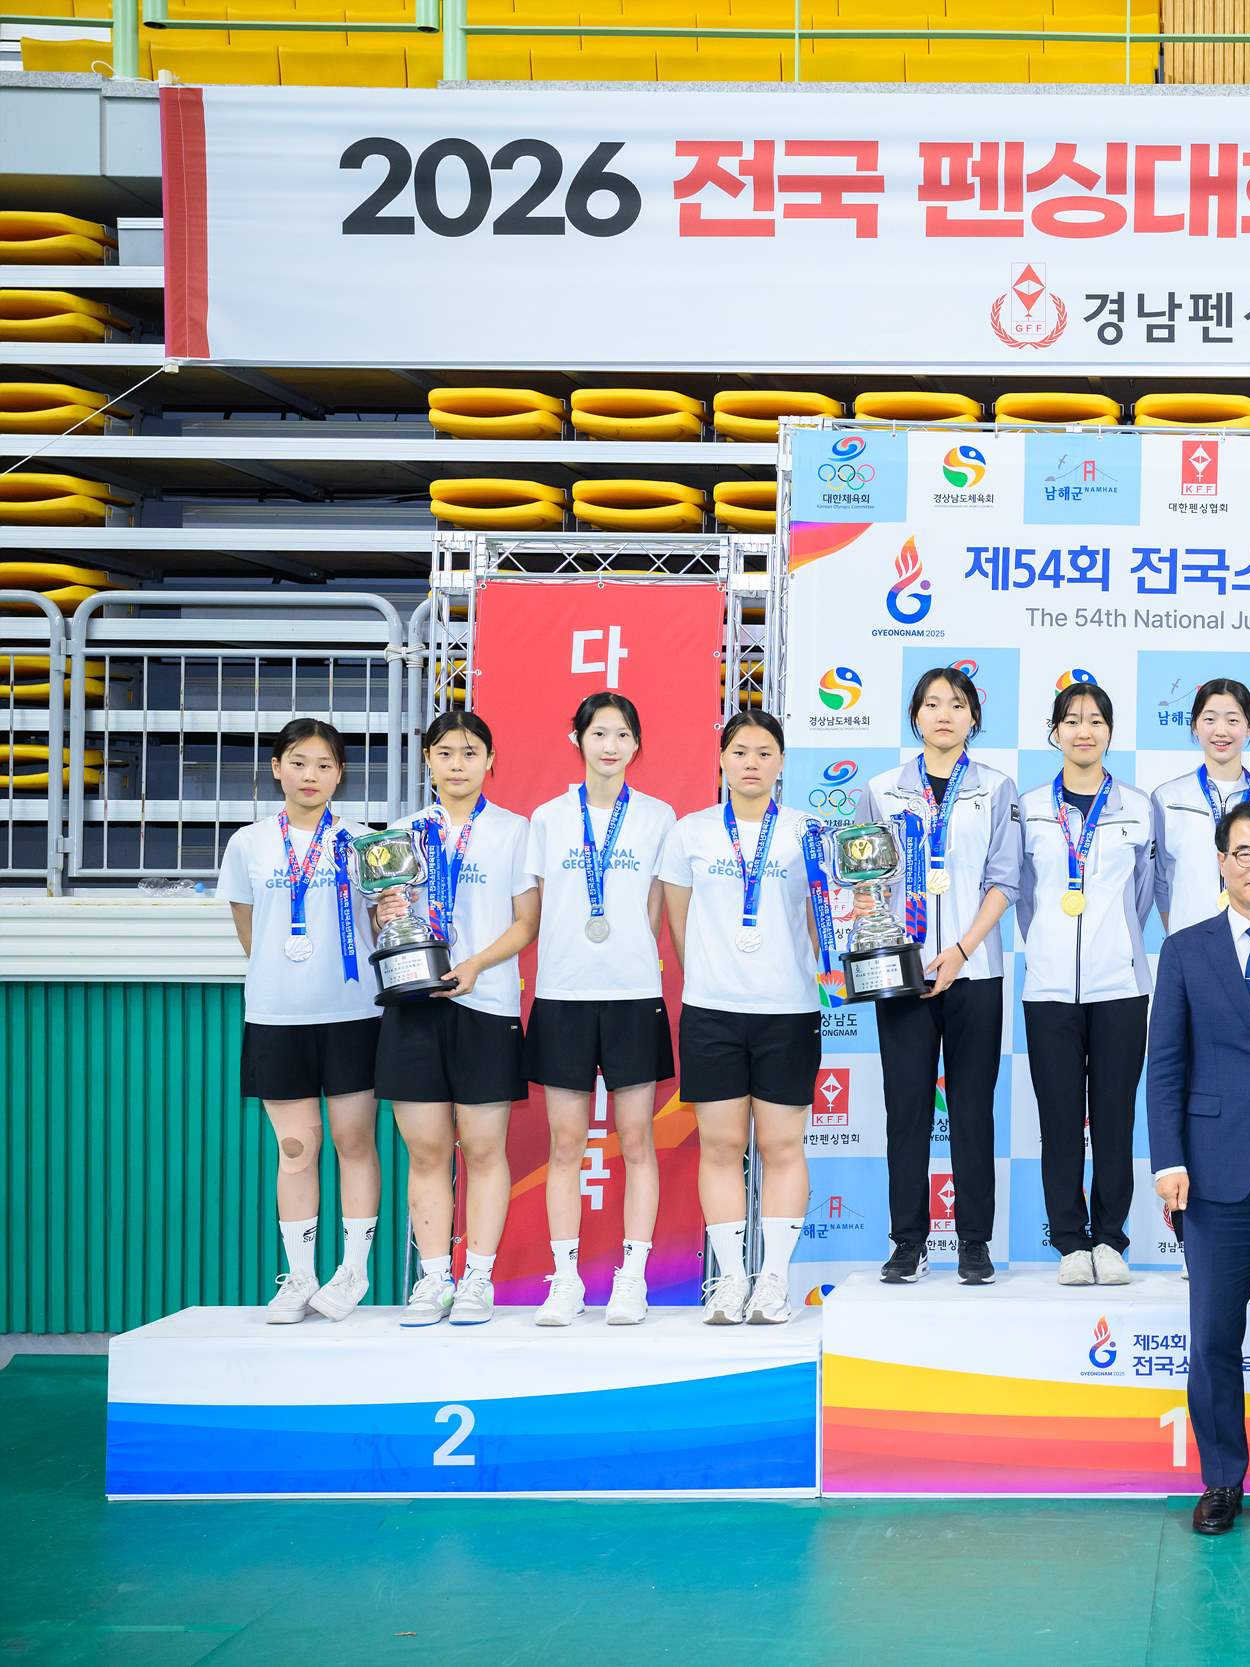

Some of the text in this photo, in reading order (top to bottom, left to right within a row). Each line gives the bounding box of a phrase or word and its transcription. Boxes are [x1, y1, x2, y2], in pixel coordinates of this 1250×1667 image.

[340, 137, 642, 237] 2026
[673, 140, 884, 238] 전국
[1045, 486, 1083, 501] 남해군
[1185, 485, 1213, 493] KFF
[822, 494, 870, 504] 대한체육회
[933, 494, 994, 504] 경상남도체육회
[1168, 502, 1228, 514] 대한펜싱협회
[964, 544, 1111, 592] 제54회
[1026, 608, 1068, 628] The
[1074, 608, 1127, 628] 54th
[1133, 609, 1225, 630] National
[871, 629, 925, 637] GYEONGNAM
[809, 716, 870, 726] 경상남도체육회
[821, 1013, 857, 1027] 상남도
[816, 1116, 844, 1124] KFF
[803, 1224, 829, 1239] 해군
[934, 1221, 951, 1229] KF
[1133, 1334, 1187, 1350] 제54회
[433, 1405, 475, 1465] 2
[1160, 1406, 1187, 1467] 1
